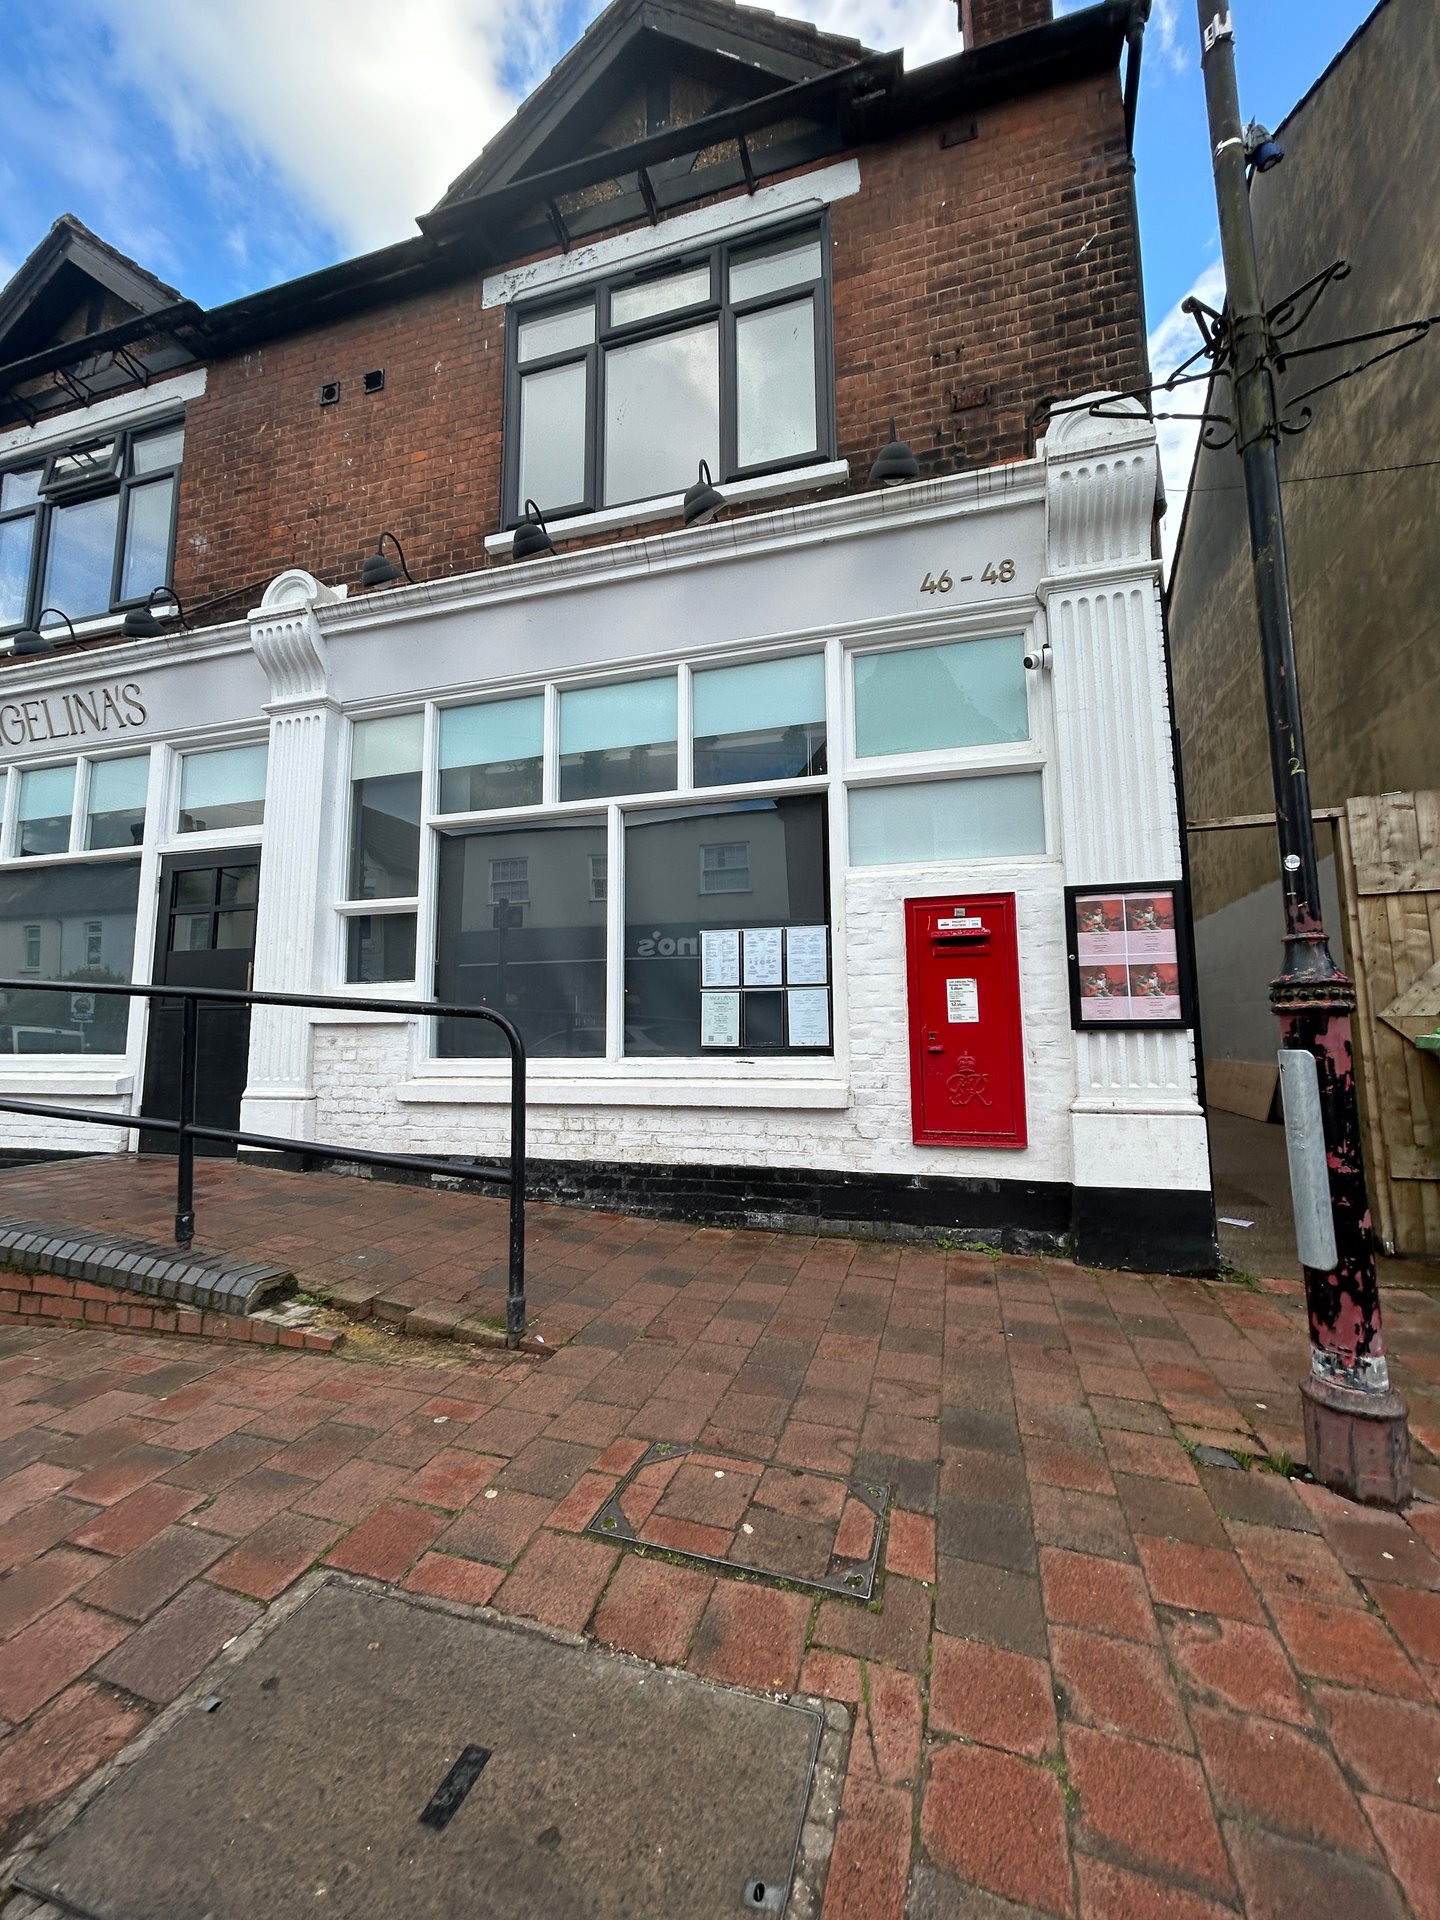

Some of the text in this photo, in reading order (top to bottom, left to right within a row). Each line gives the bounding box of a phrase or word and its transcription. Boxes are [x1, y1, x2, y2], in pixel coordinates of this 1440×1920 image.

[920, 569, 953, 594] 46
[980, 559, 1015, 584] 48
[0, 683, 147, 746] GELINA'S
